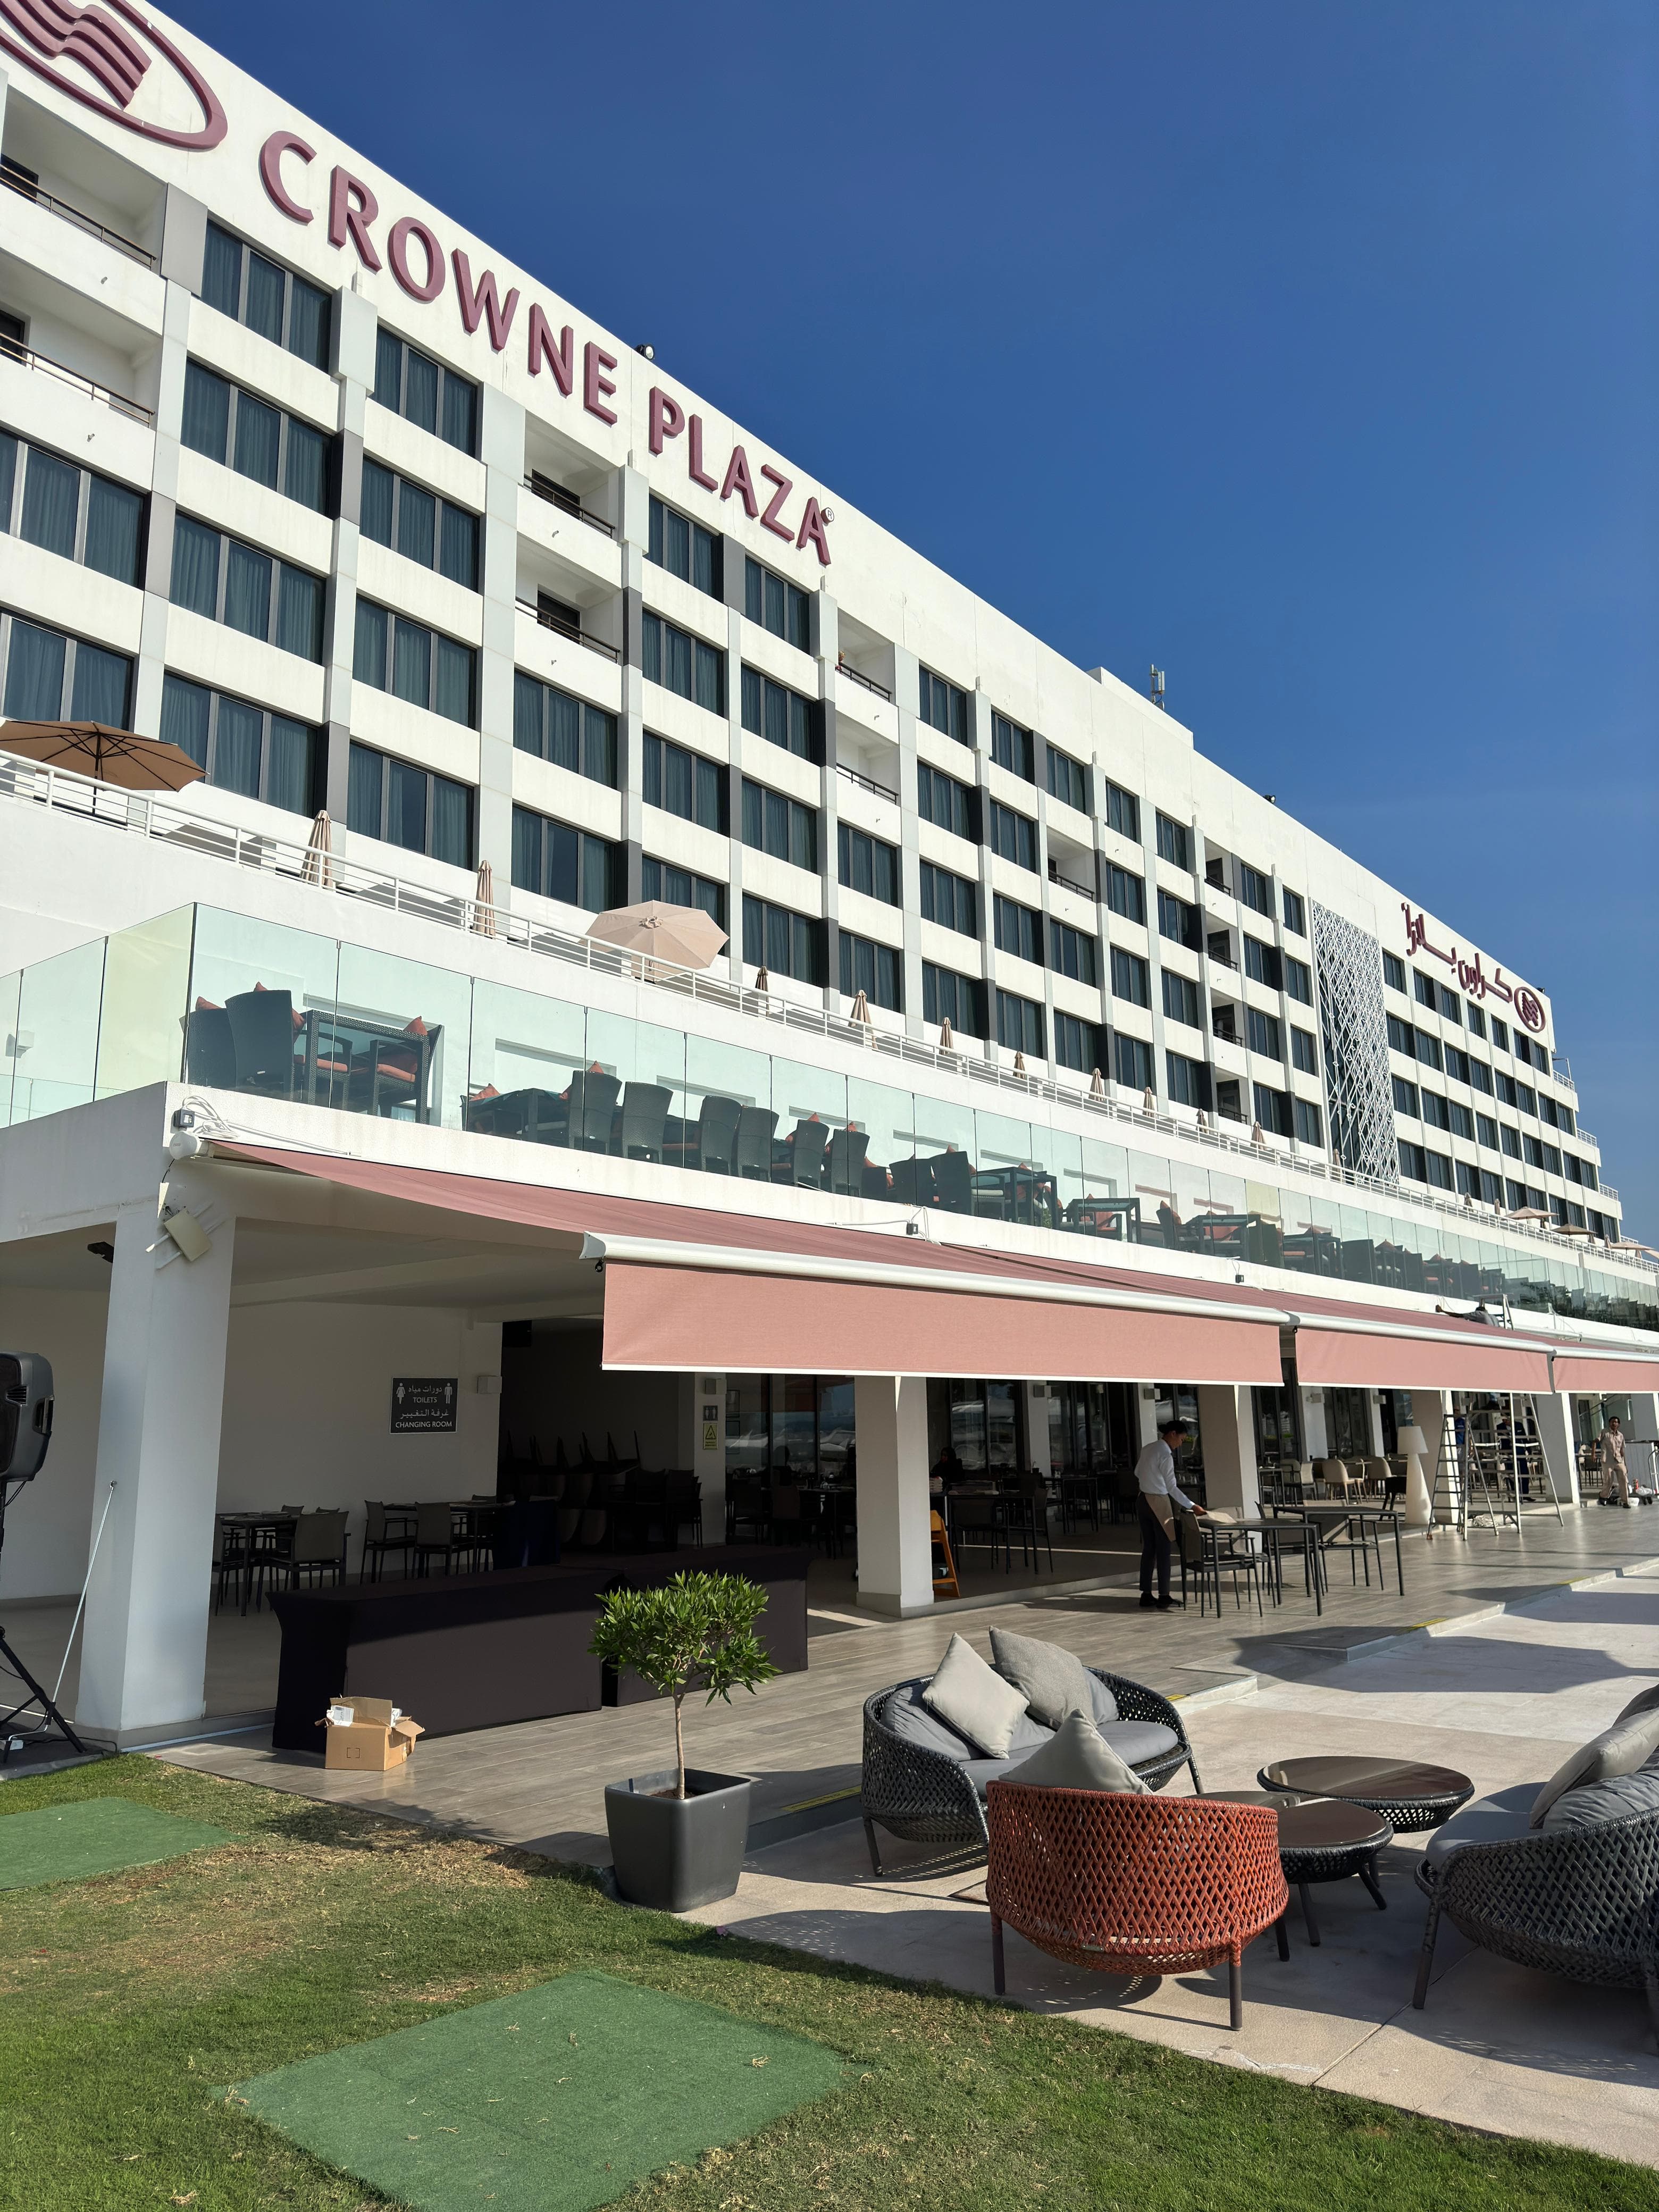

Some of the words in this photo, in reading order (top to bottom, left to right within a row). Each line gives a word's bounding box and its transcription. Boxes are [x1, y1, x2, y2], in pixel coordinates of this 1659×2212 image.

[260, 130, 618, 424] CROWNE
[1404, 904, 1457, 974] بلازا
[1457, 952, 1513, 1003] كراون
[423, 1385, 442, 1394] دورات
[400, 1409, 429, 1419] التغيير
[431, 1409, 449, 1418] غرفة
